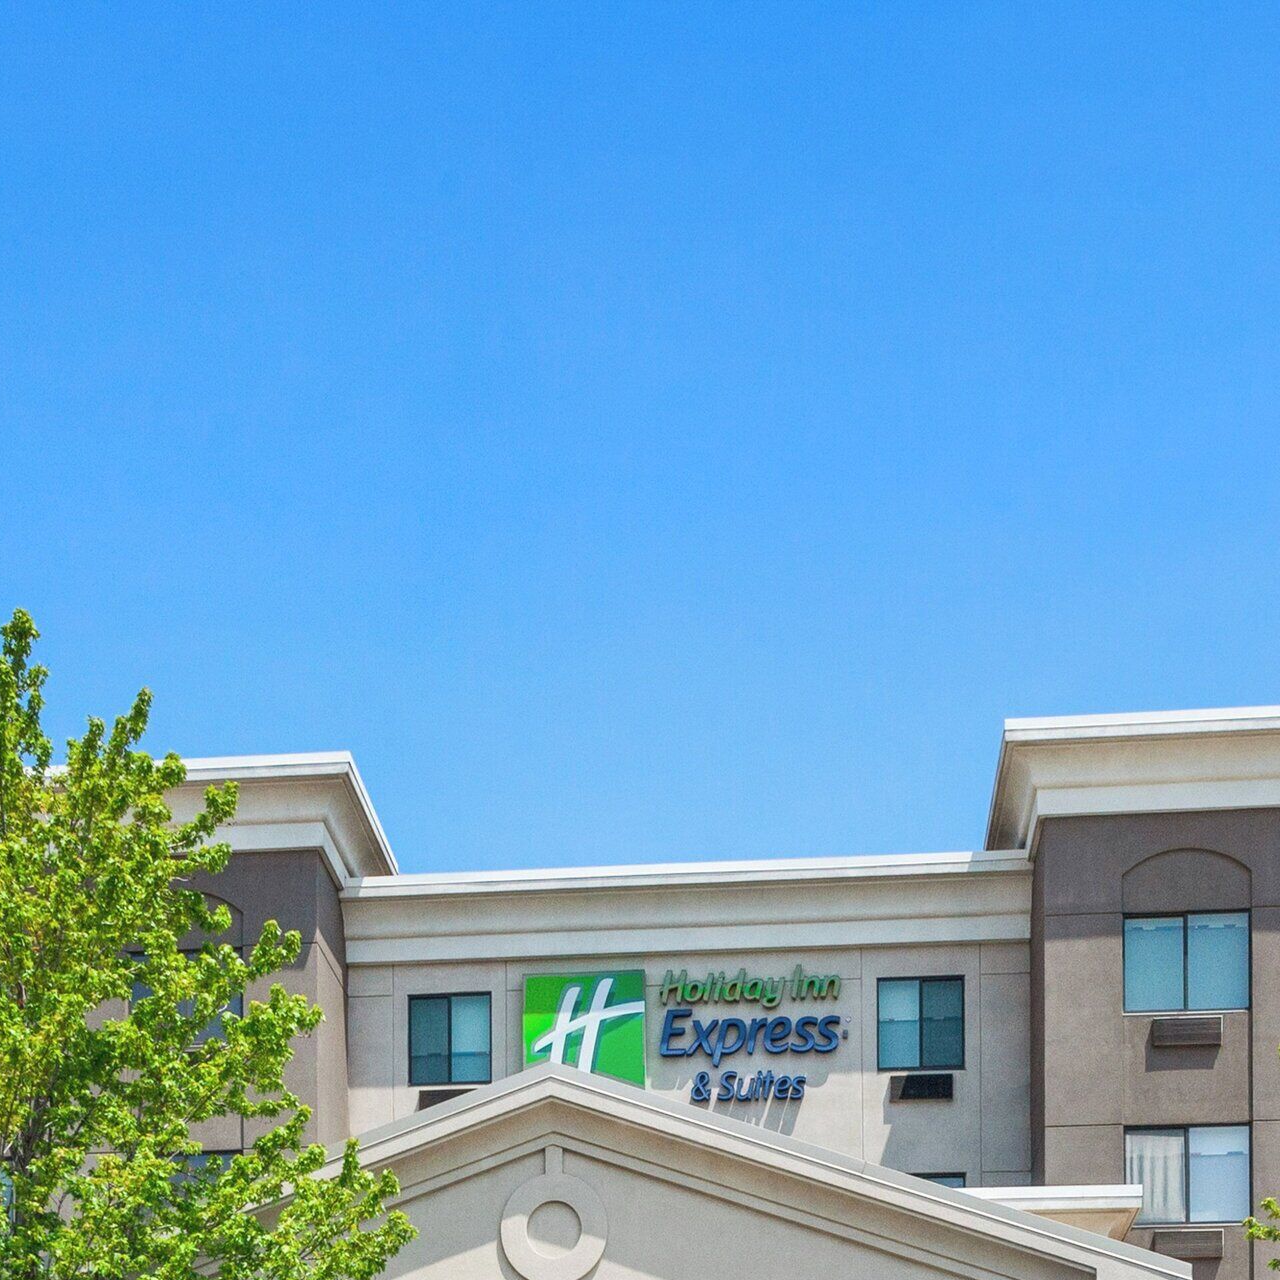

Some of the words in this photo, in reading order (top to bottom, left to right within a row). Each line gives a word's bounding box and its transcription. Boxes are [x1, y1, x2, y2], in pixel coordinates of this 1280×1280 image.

[660, 968, 786, 1009] Holiday
[791, 964, 842, 1000] Inn
[659, 1008, 841, 1068] Express
[691, 1071, 711, 1101] &
[718, 1070, 807, 1101] Suites
